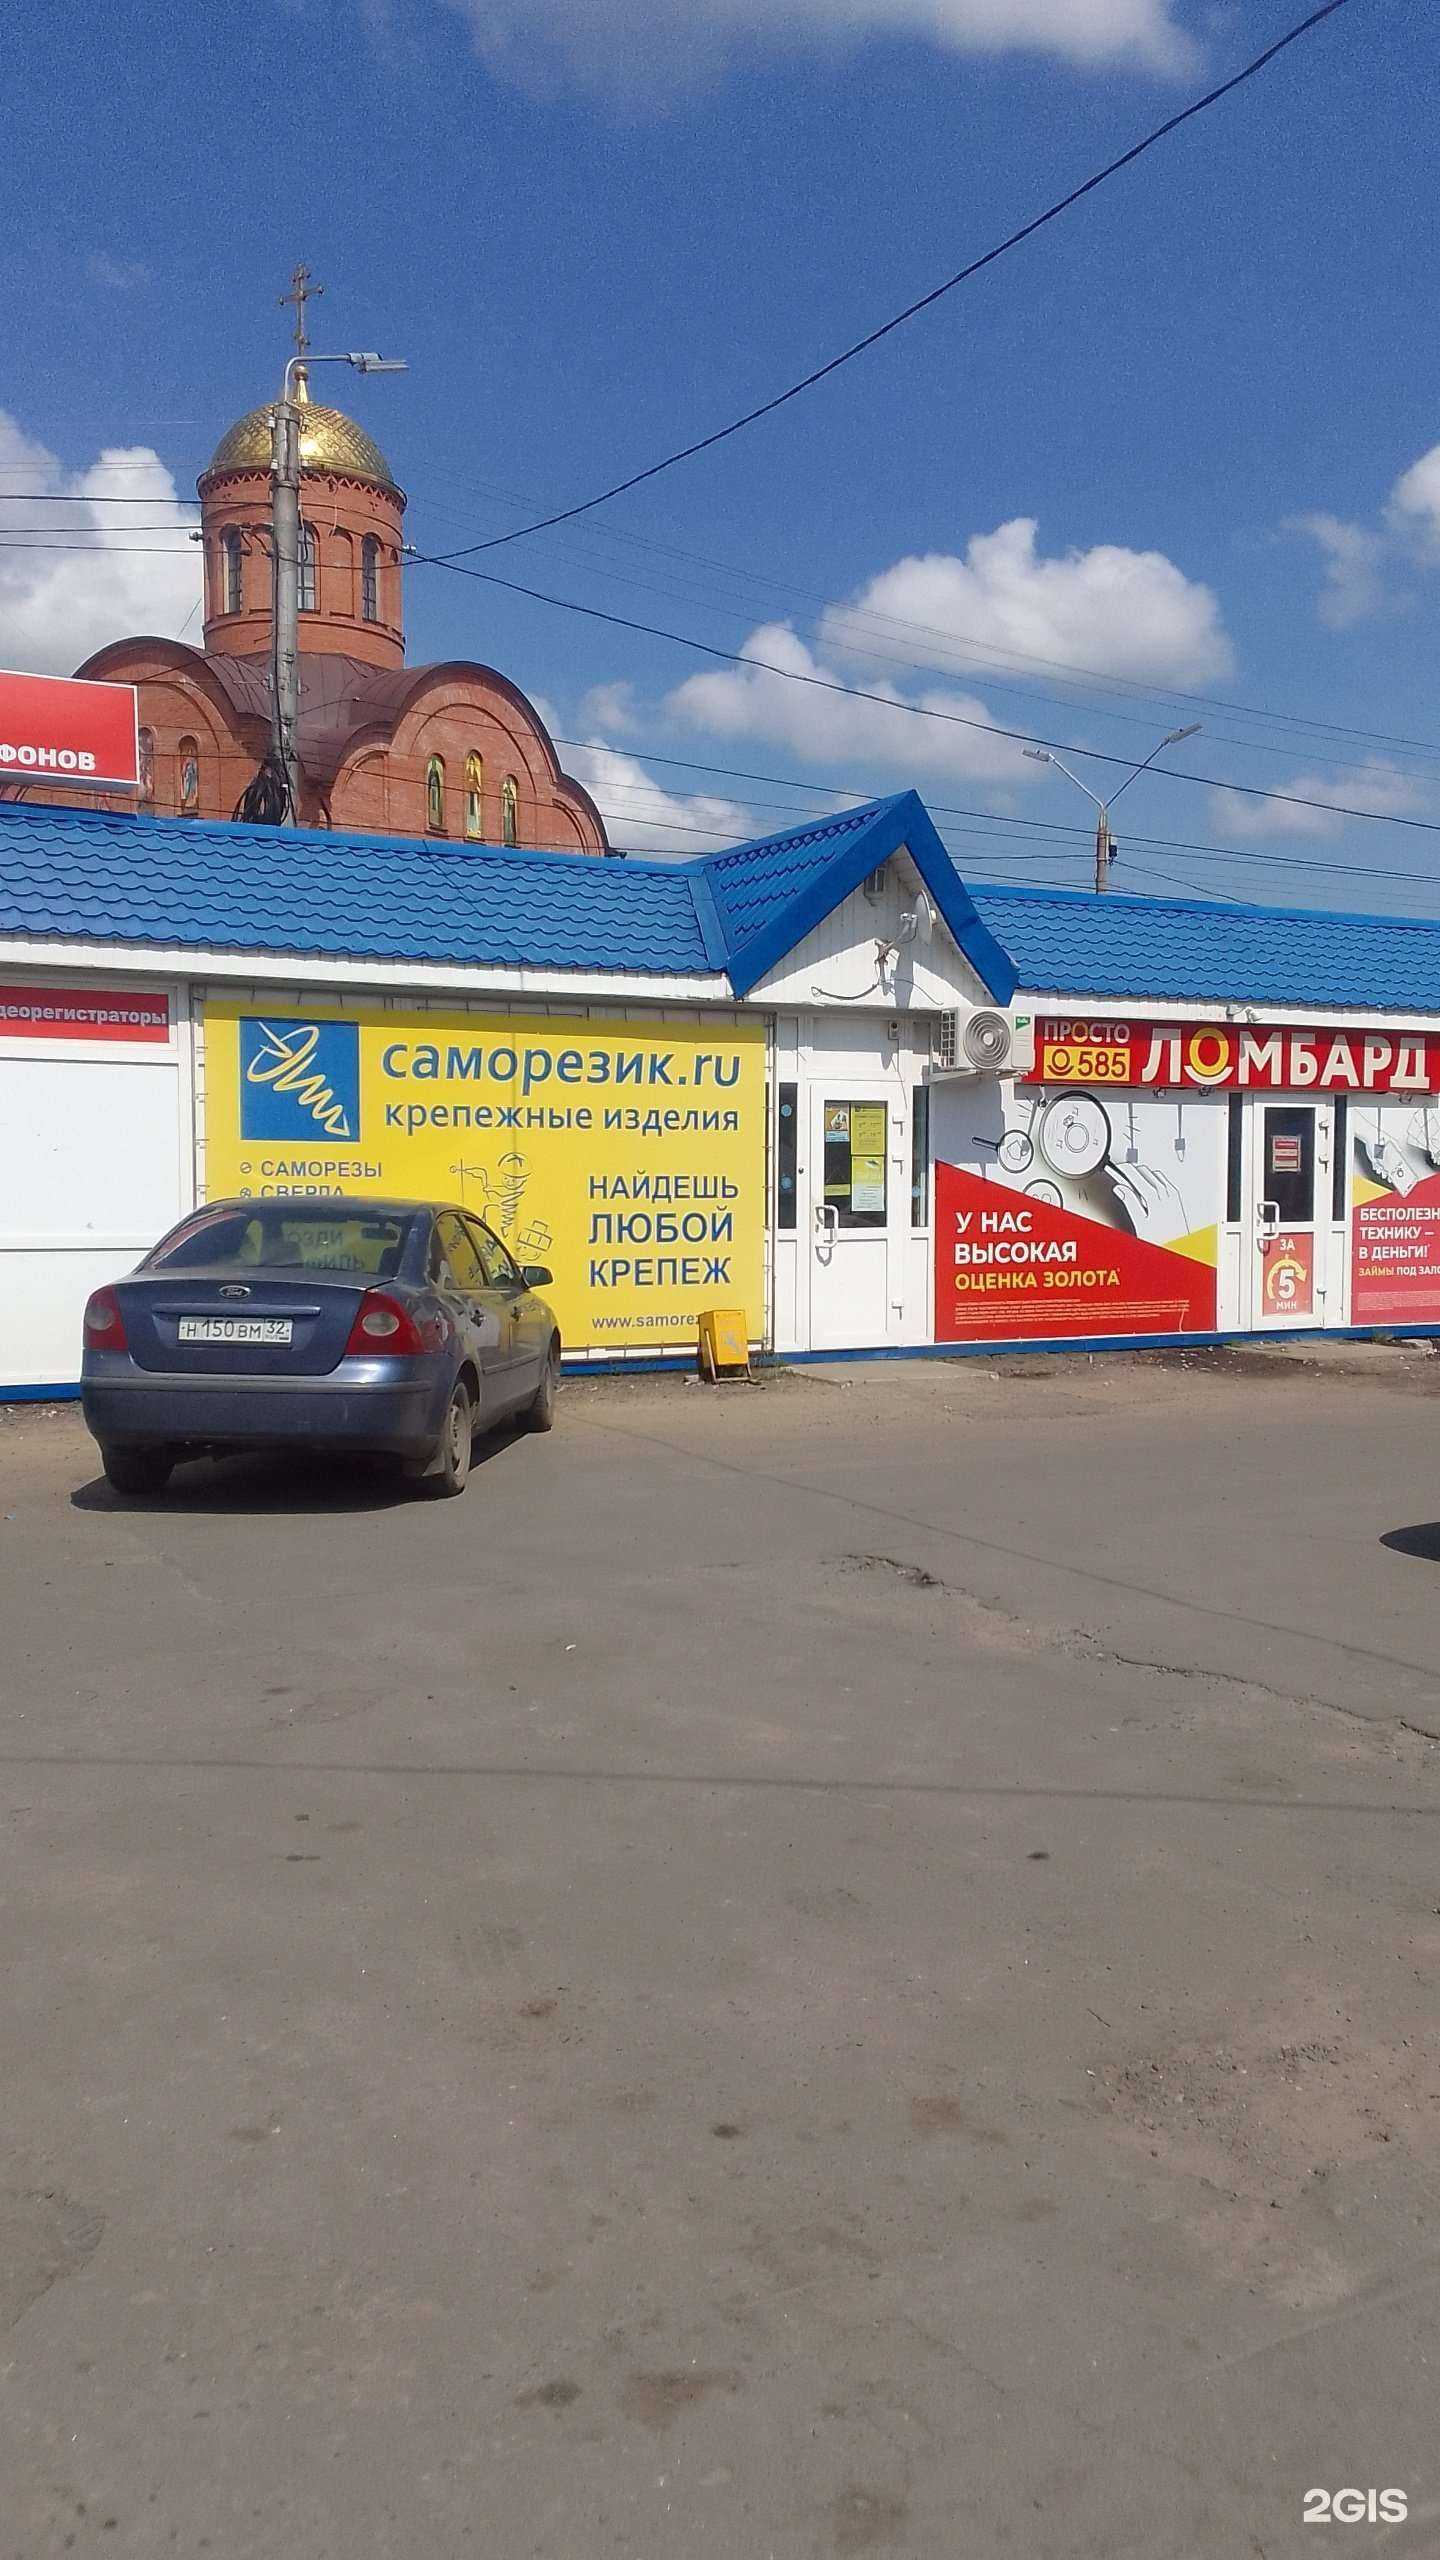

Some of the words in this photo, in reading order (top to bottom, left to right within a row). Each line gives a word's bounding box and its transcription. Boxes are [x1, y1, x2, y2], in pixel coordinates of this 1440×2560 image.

[1043, 1020, 1130, 1044] ПРОСТО
[382, 1043, 741, 1096] саморезик.ru
[1077, 1050, 1127, 1078] 585
[1141, 1026, 1431, 1090] ЛОМБАРД
[384, 1103, 593, 1136] крепежные
[602, 1107, 739, 1136] изделия
[260, 1160, 383, 1178] САМОРЕЗЫ
[260, 1184, 344, 1197] СВЕРЛА
[588, 1169, 739, 1204] НАЙДЕШЬ
[588, 1205, 734, 1244] ЛЮБОЙ
[956, 1211, 974, 1234] У
[980, 1211, 1034, 1233] НАС
[1360, 1226, 1422, 1240] ТЕХНИКУ
[953, 1241, 1078, 1265] ВЫСОКАЯ
[1279, 1238, 1296, 1251] ЗА
[1358, 1246, 1368, 1260] В
[589, 1256, 731, 1287] КРЕПЕЖ
[955, 1271, 1037, 1292] ОЦЕНКА
[1358, 1266, 1394, 1277] ЗАЙМЫ
[1396, 1266, 1417, 1277] ПОД
[1278, 1269, 1296, 1299] 5
[1276, 1301, 1297, 1311] МИН
[266, 1320, 285, 1335] 32
